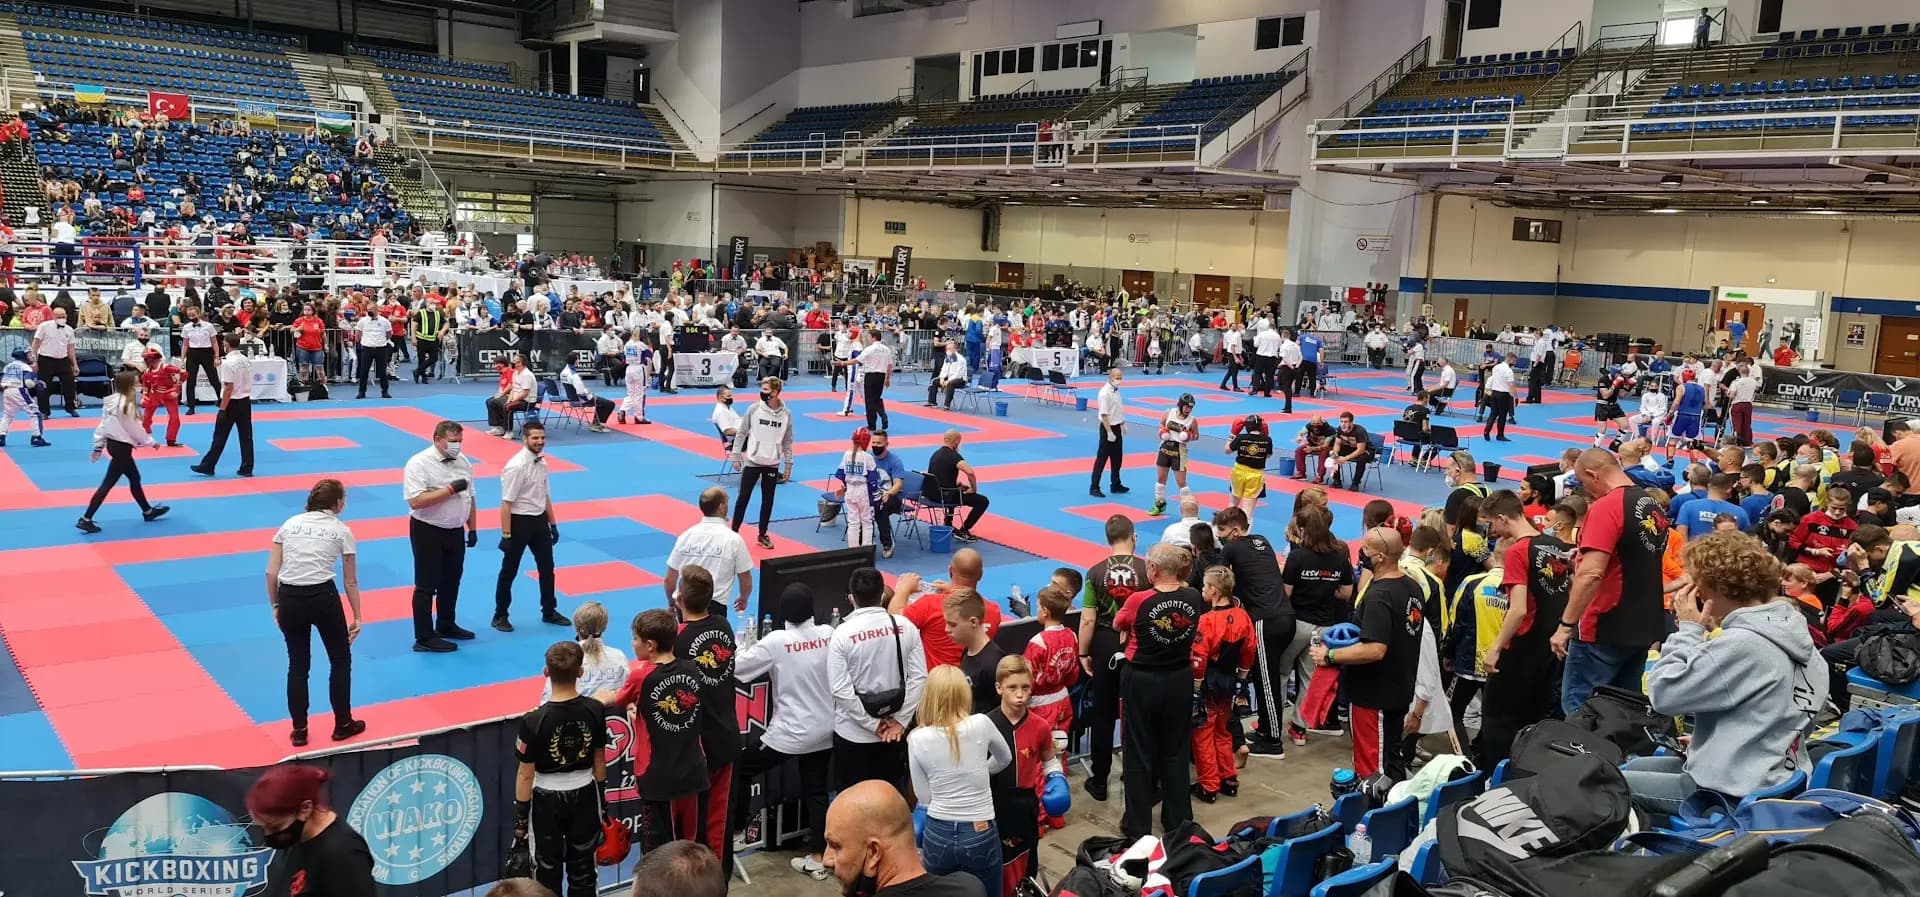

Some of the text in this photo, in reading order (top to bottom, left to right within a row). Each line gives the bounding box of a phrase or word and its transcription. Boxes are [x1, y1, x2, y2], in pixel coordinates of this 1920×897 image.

[893, 247, 908, 291] CENTURY
[701, 358, 711, 376] 3
[1053, 351, 1061, 366] 5
[1777, 383, 1834, 399] CENTURY
[784, 636, 832, 654] TÜRKİY
[370, 798, 463, 841] WAKO
[386, 765, 403, 779] OF
[404, 758, 470, 785] KICKBOXING
[438, 779, 481, 866] ORGANIZATIONS
[1474, 787, 1561, 859] NIKE
[94, 857, 259, 886] KICKBOXING
[124, 886, 232, 897] WORLD SERIES
